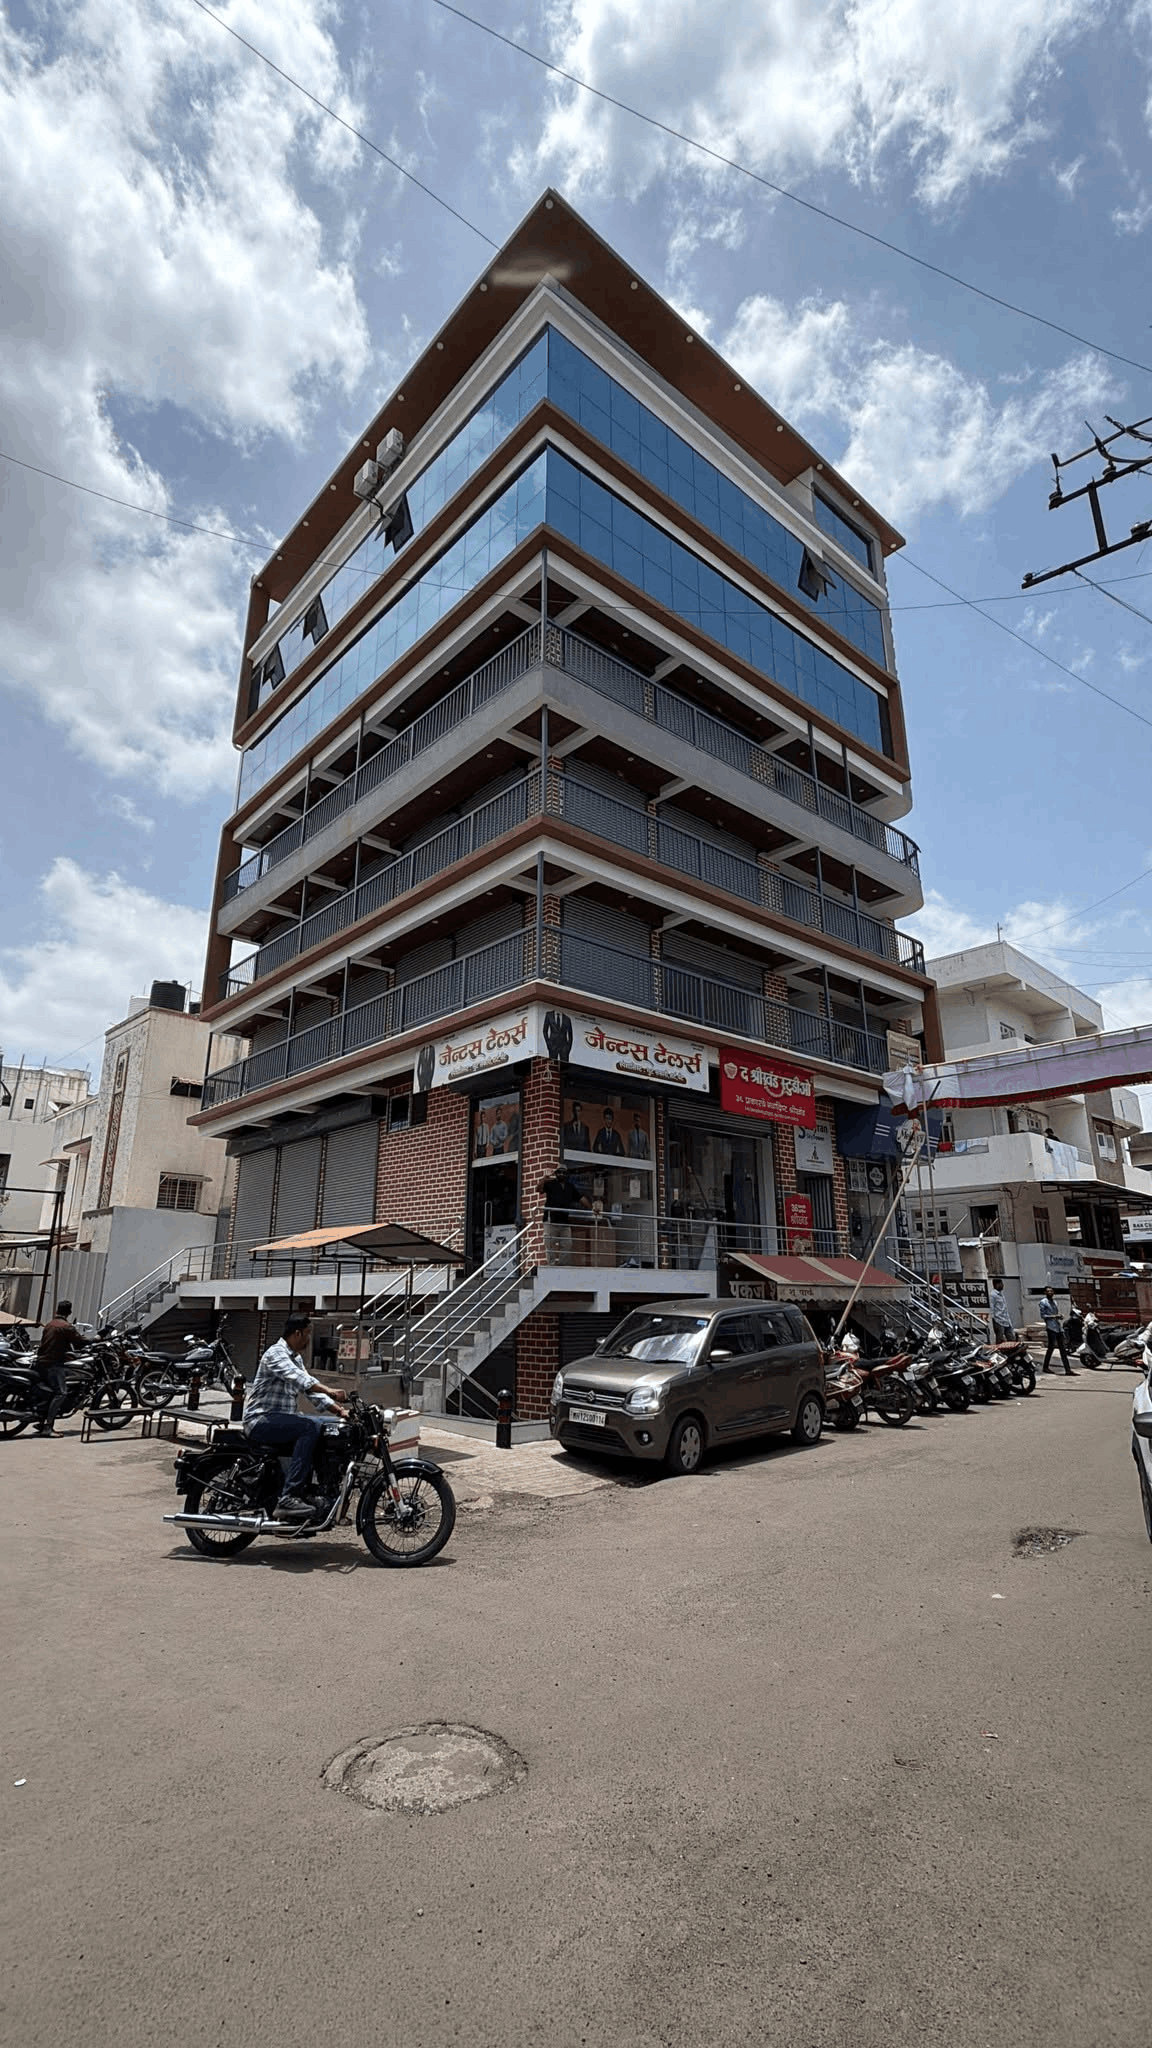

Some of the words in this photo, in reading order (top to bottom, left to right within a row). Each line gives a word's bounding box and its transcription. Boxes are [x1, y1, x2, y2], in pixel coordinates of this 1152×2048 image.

[486, 1016, 529, 1051] टेलर्स
[653, 1042, 702, 1074] टेलर्स
[739, 1066, 749, 1082] द
[728, 1273, 766, 1300] पंकज
[959, 1279, 986, 1292] पंकज
